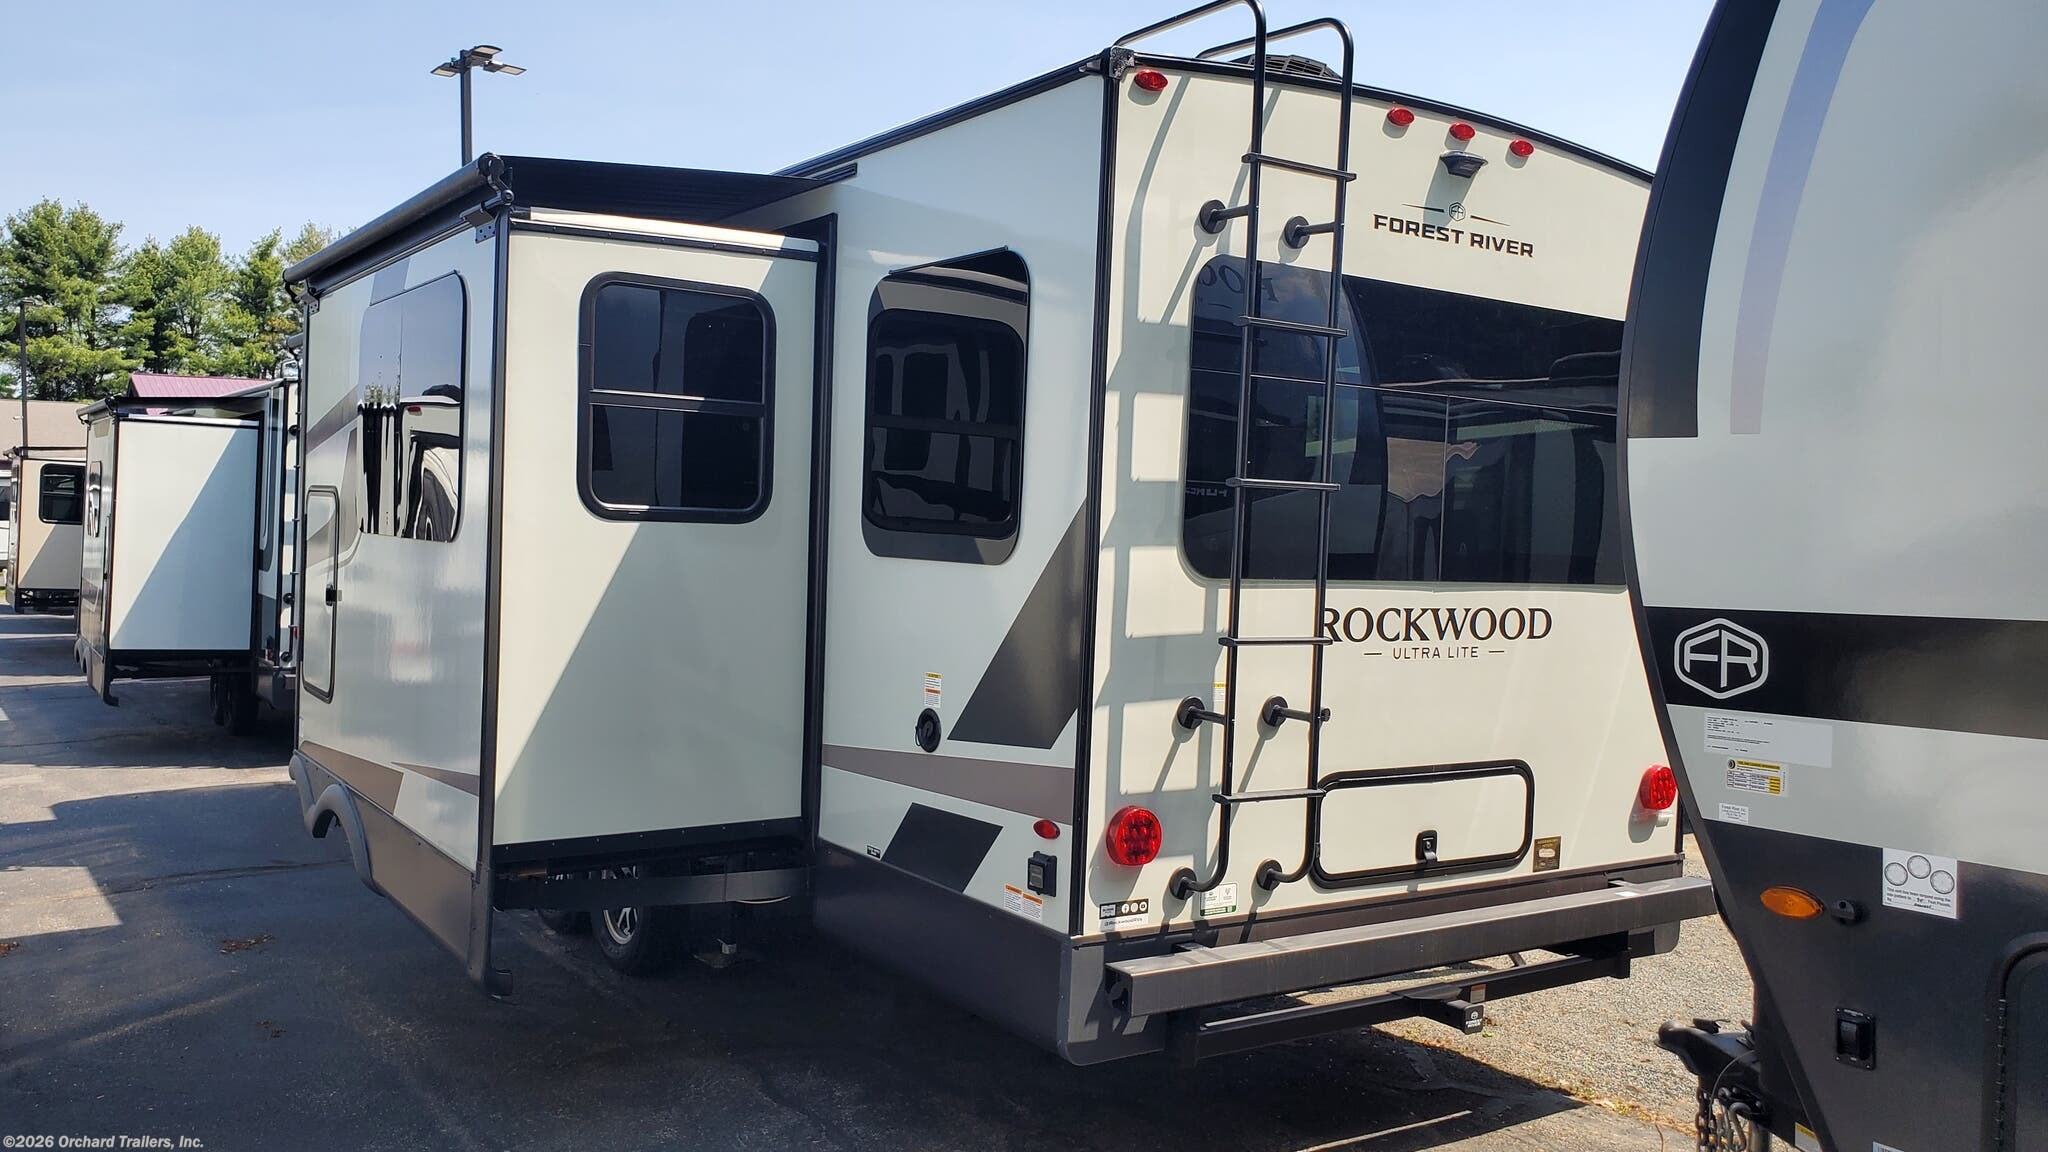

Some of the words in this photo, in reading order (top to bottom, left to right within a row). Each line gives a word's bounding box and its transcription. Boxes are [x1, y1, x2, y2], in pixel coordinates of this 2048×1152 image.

[1373, 214, 1464, 244] FOREST
[1469, 232, 1534, 257] RIVER
[1323, 607, 1553, 643] ROCKWOOD
[1393, 647, 1441, 660] ULTRA
[1447, 646, 1479, 658] LITE
